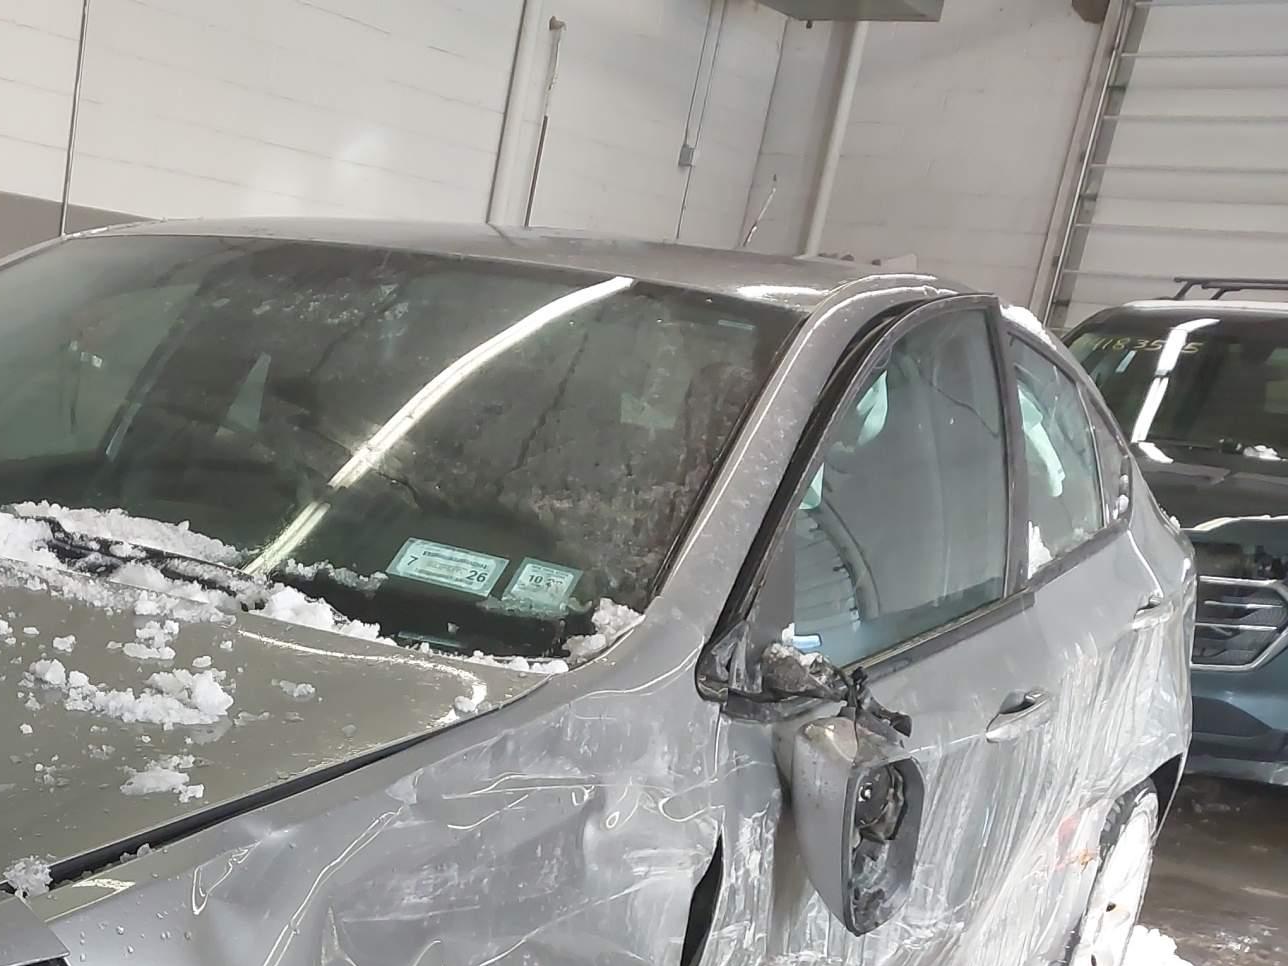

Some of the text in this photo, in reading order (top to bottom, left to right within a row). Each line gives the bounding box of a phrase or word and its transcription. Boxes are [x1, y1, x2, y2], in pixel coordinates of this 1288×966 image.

[407, 555, 419, 566] 7
[466, 570, 489, 583] 26
[528, 574, 544, 584] 10
